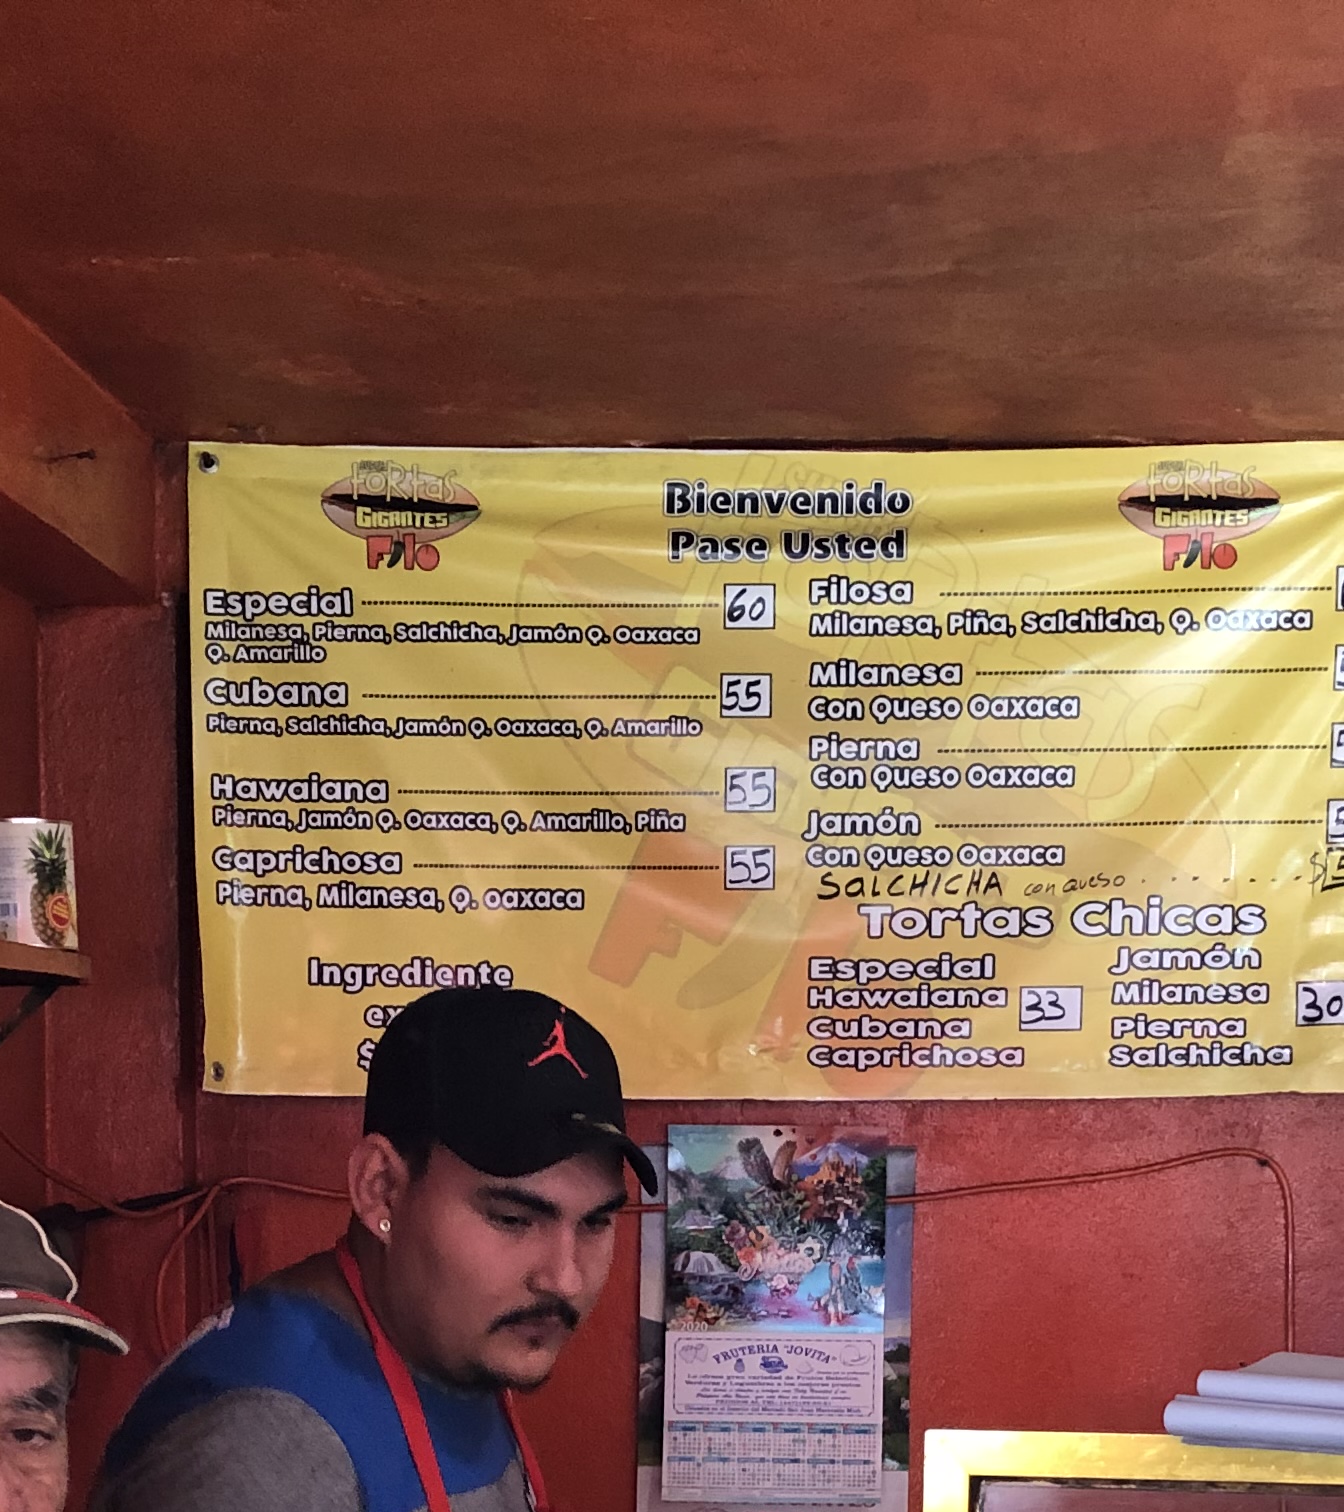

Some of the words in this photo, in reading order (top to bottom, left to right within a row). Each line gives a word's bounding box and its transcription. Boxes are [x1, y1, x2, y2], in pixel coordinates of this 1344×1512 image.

[664, 480, 911, 516] Bienvenido
[356, 506, 449, 529] GIGANTES
[1153, 507, 1249, 528] GIGANTES
[669, 531, 768, 561] Pase
[782, 527, 909, 561] Usted
[203, 585, 353, 622] Especial
[727, 590, 767, 623] 60
[809, 575, 913, 605] Filosa
[205, 619, 312, 647] Milanesa,
[312, 620, 392, 645] Pierna,
[394, 620, 506, 645] Salchicha,
[506, 623, 582, 646] Jamón
[613, 625, 700, 645] Oaxaca
[809, 610, 942, 639] Milanesa,
[947, 609, 1016, 638] Piña,
[1021, 607, 1164, 634] Salchicha,
[1207, 608, 1312, 631] Oaxaca
[234, 641, 327, 663] Amarillo
[809, 658, 962, 687] Milanesa
[204, 677, 348, 708] Cubana
[722, 679, 763, 712] 55
[872, 695, 962, 724] Queso
[968, 694, 1079, 719] Oaxaca
[207, 712, 283, 737] Pierna,
[285, 714, 394, 738] Salchicha,
[392, 716, 466, 739] Jamón
[495, 717, 582, 739] Oaxaca,
[611, 715, 703, 736] Amarillo
[809, 733, 920, 761] Pierna
[211, 772, 389, 803] Hawaiana
[728, 772, 773, 808] 55
[871, 765, 961, 792] Queso
[966, 764, 1075, 788] Oaxaca
[212, 805, 296, 832] Pierna,
[295, 806, 373, 833] Jamón
[404, 809, 498, 834] Oaxaca,
[529, 808, 632, 835] Amarillo,
[635, 809, 686, 832] Piña
[801, 807, 921, 842] Jamón
[212, 844, 402, 878] Caprichosa
[728, 850, 772, 884] 55
[864, 846, 953, 871] Queso
[957, 844, 1065, 866] Oaxaca
[216, 879, 312, 911] Pierna,
[316, 880, 444, 913] Milanesa,
[485, 888, 584, 910] oaxaca
[858, 901, 1054, 939] Tortas
[1071, 896, 1266, 936] Chicas
[808, 952, 995, 988] Especial
[1108, 943, 1261, 975] Jamón
[308, 957, 513, 994] Ingrediente
[807, 983, 1008, 1009] Hawaiana
[1112, 978, 1269, 1004] Milanesa
[1021, 989, 1067, 1024] 33
[1301, 989, 1343, 1024] 30
[807, 1014, 971, 1040] Cubana
[1111, 1014, 1246, 1039] Pierna
[807, 1042, 1024, 1072] Caprichosa
[1109, 1041, 1293, 1067] Salchicha
[680, 1321, 708, 1333] 2020
[712, 1344, 779, 1364] FRUTERIA
